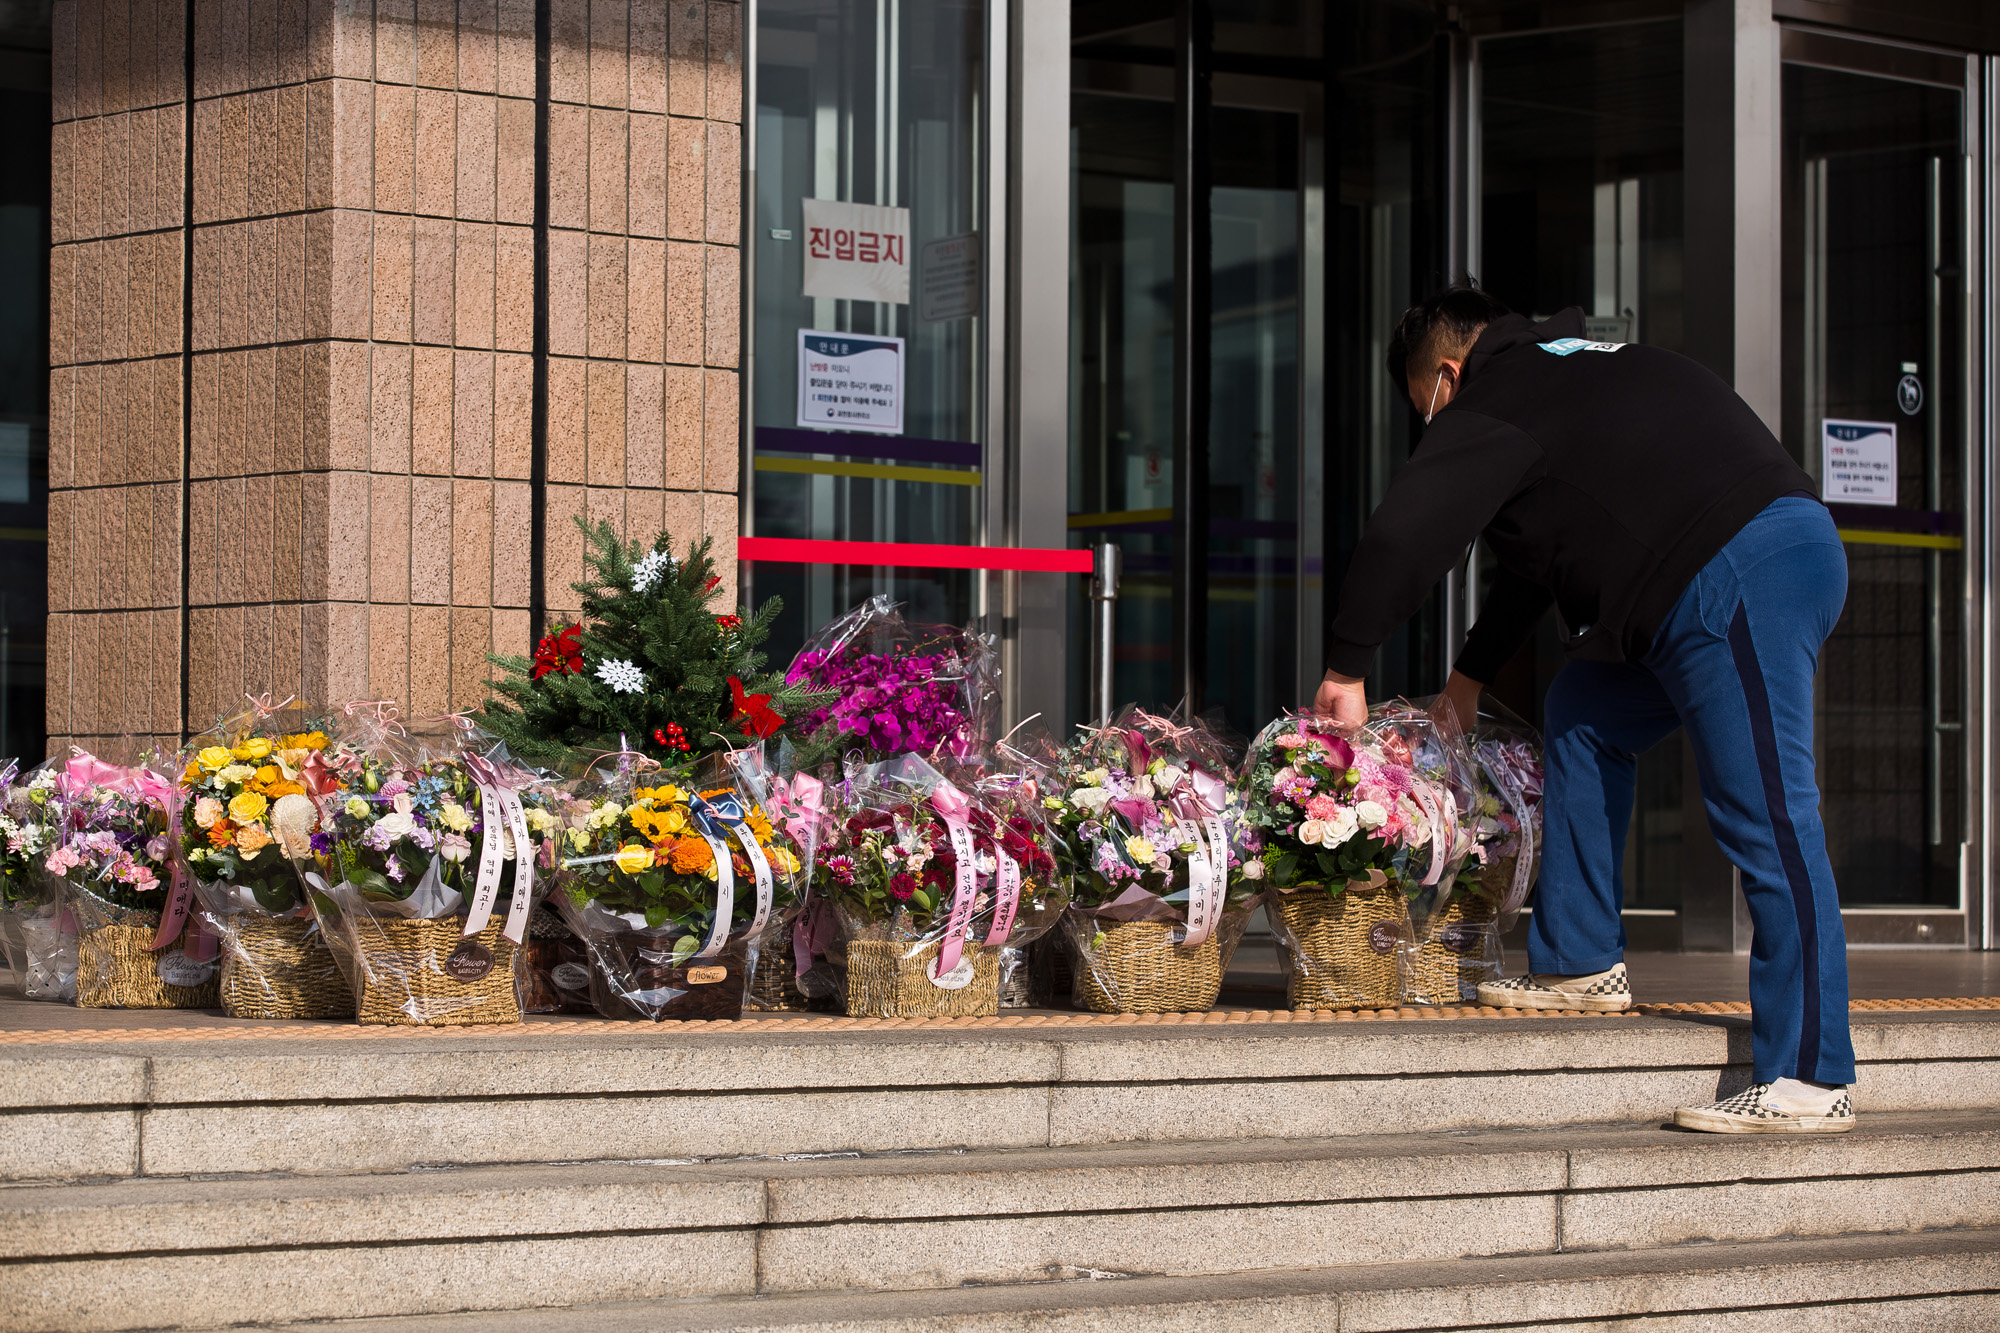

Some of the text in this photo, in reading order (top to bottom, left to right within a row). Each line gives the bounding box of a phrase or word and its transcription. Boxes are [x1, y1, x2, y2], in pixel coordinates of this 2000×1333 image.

[809, 227, 904, 265] 진입금지
[510, 801, 528, 915] 우리가 추미애다
[954, 828, 972, 868] 힘내시고
[755, 878, 769, 928] 추미애다
[962, 874, 973, 895] 건강
[1194, 882, 1207, 927] 추미애
[453, 951, 487, 968] Flower
